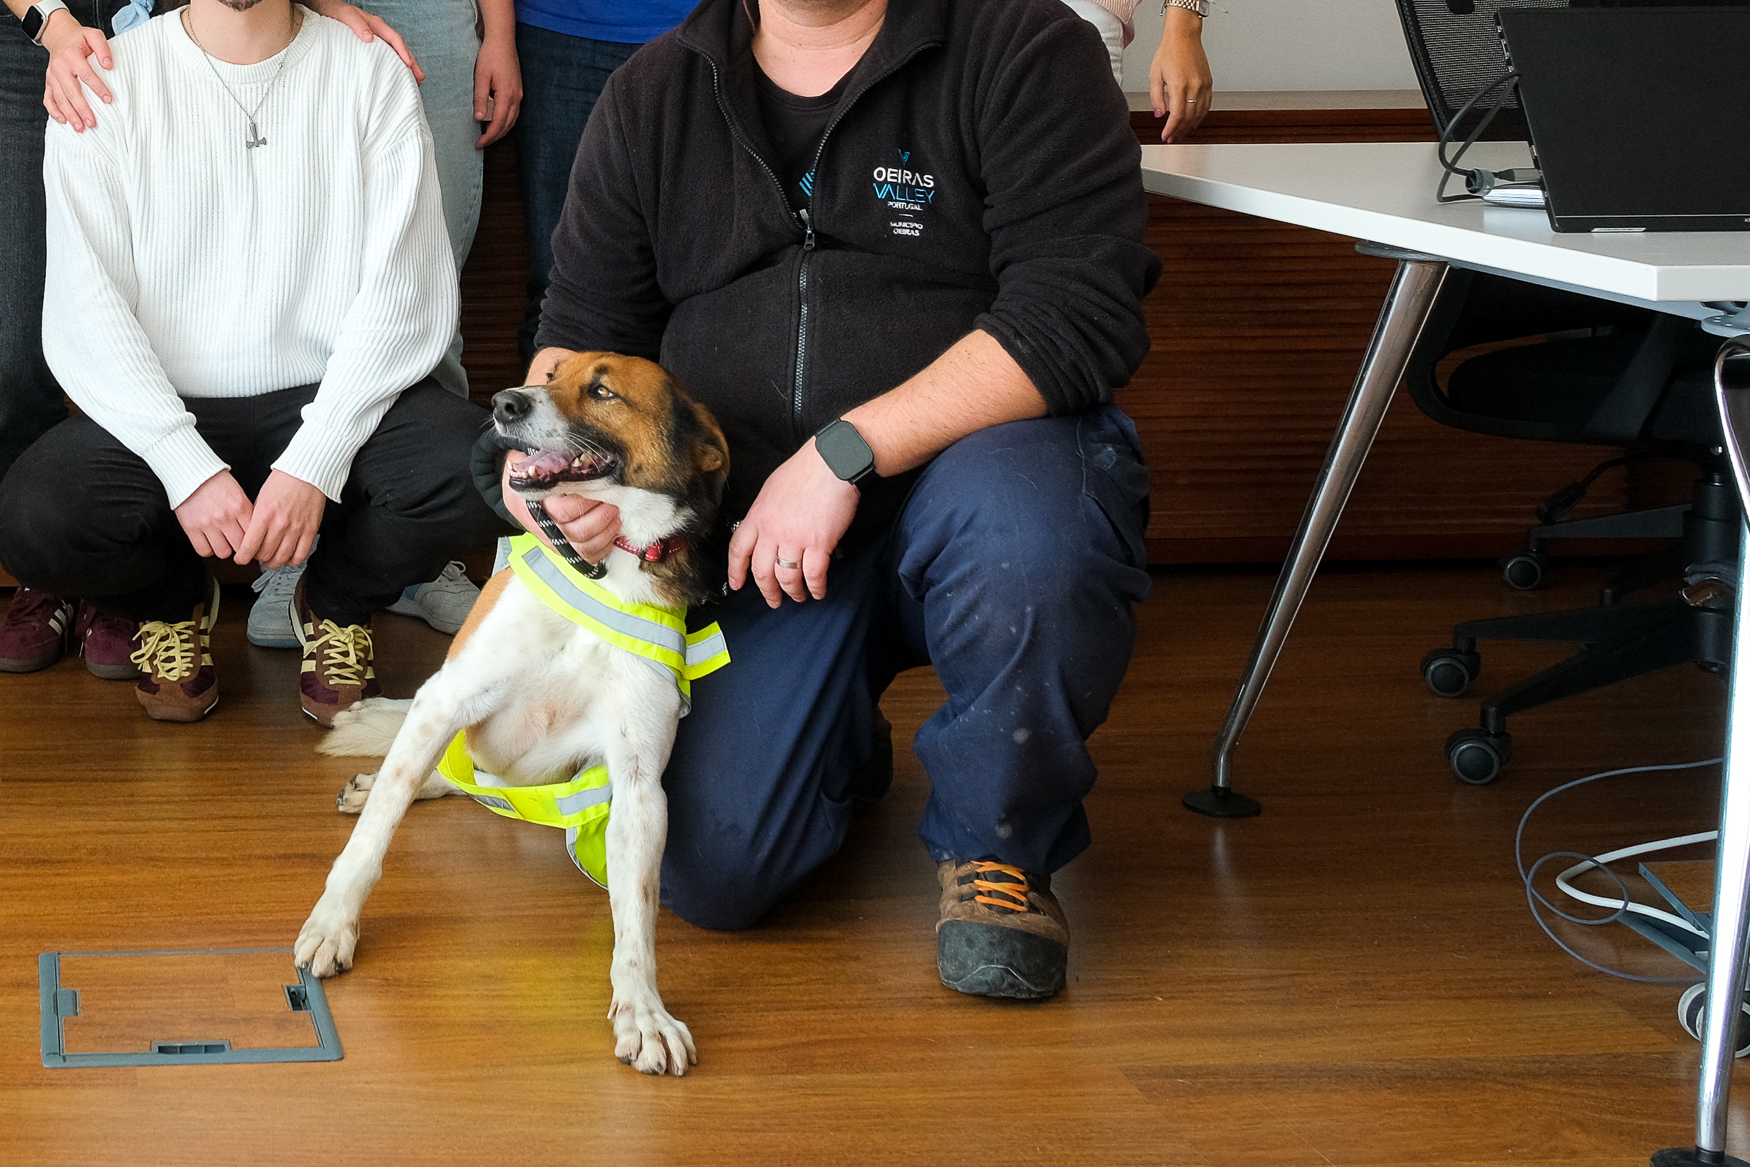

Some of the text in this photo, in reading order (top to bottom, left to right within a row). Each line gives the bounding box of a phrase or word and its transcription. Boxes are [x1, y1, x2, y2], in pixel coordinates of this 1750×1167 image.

[873, 166, 935, 188] OEIRAS
[872, 182, 935, 204] VALLEY
[887, 201, 923, 211] PORTUGAL
